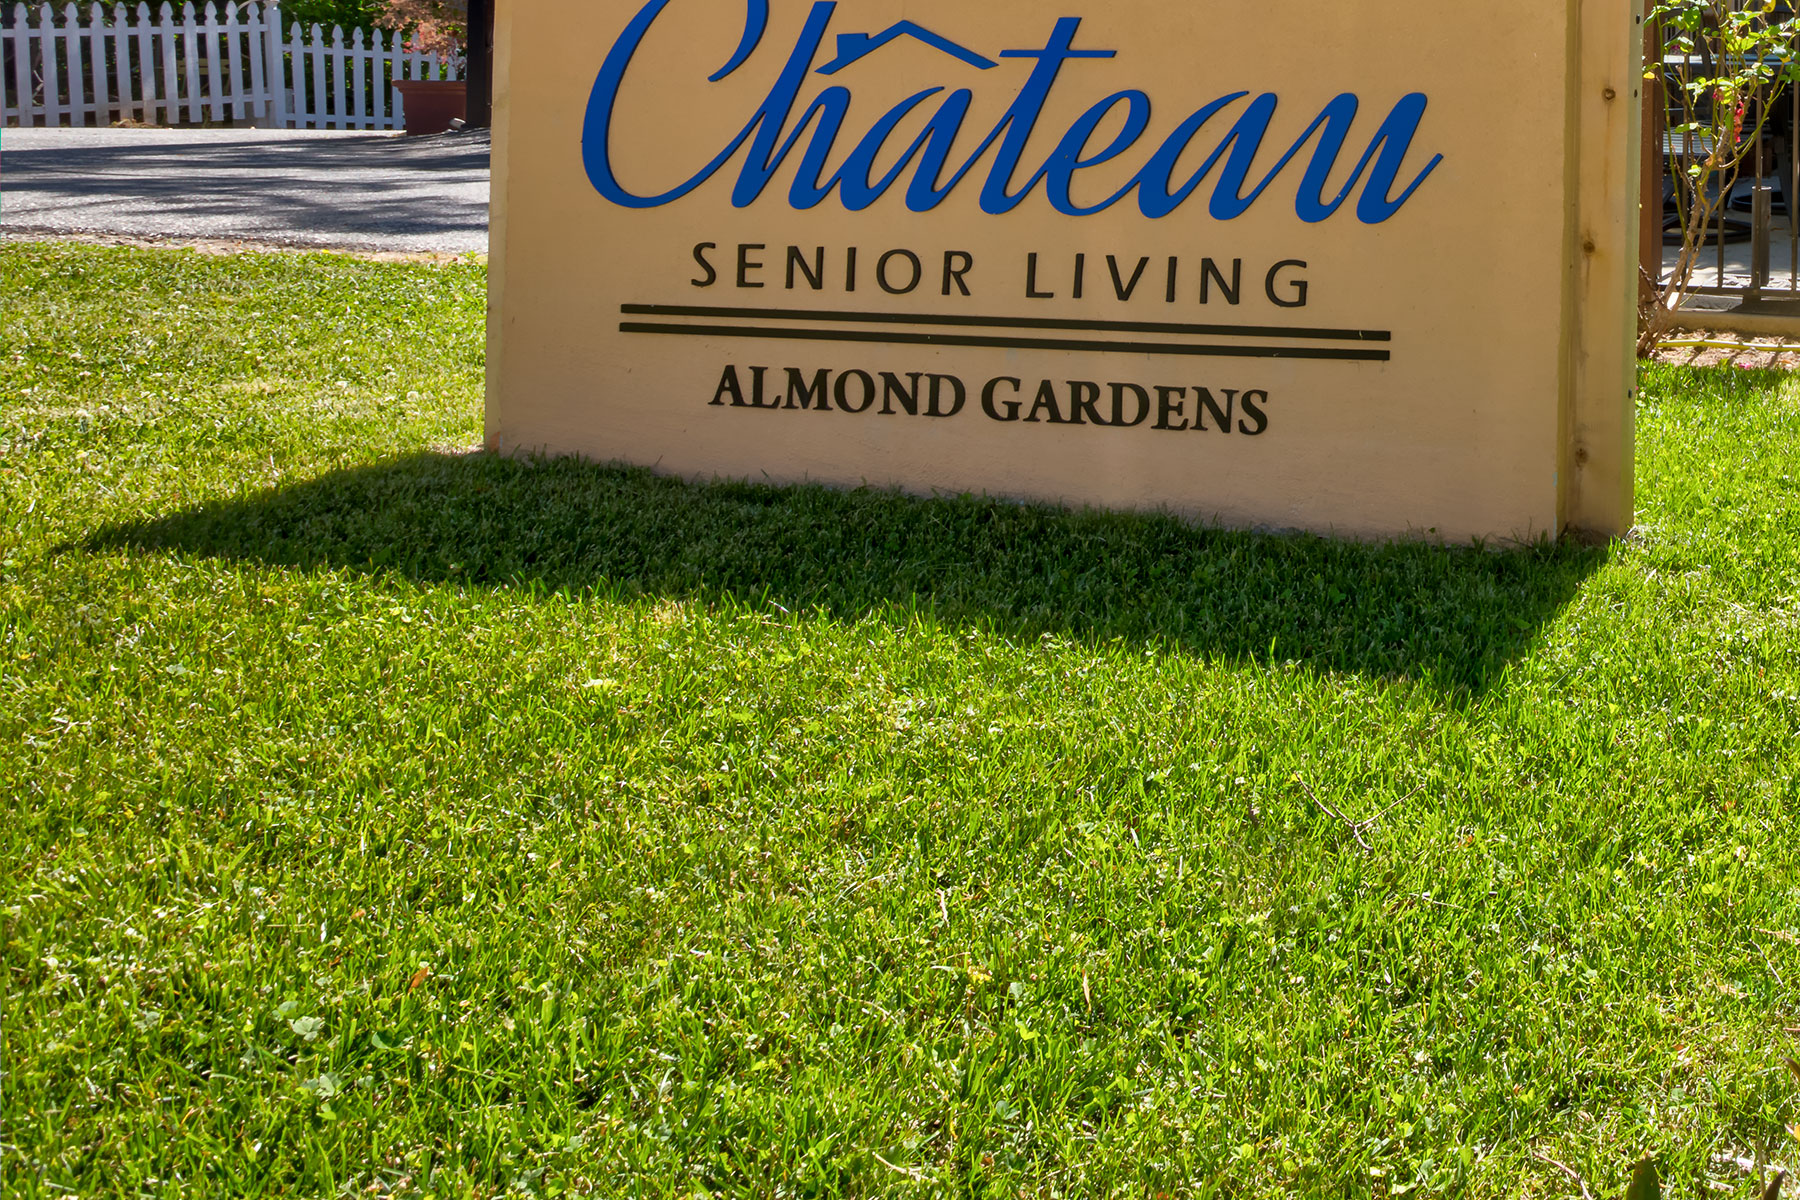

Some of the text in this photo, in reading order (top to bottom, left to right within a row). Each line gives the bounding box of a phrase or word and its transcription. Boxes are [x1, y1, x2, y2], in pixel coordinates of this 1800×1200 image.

[690, 241, 1310, 309] SENIOR LIVING
[707, 363, 1270, 439] ALMOND GARDENS
